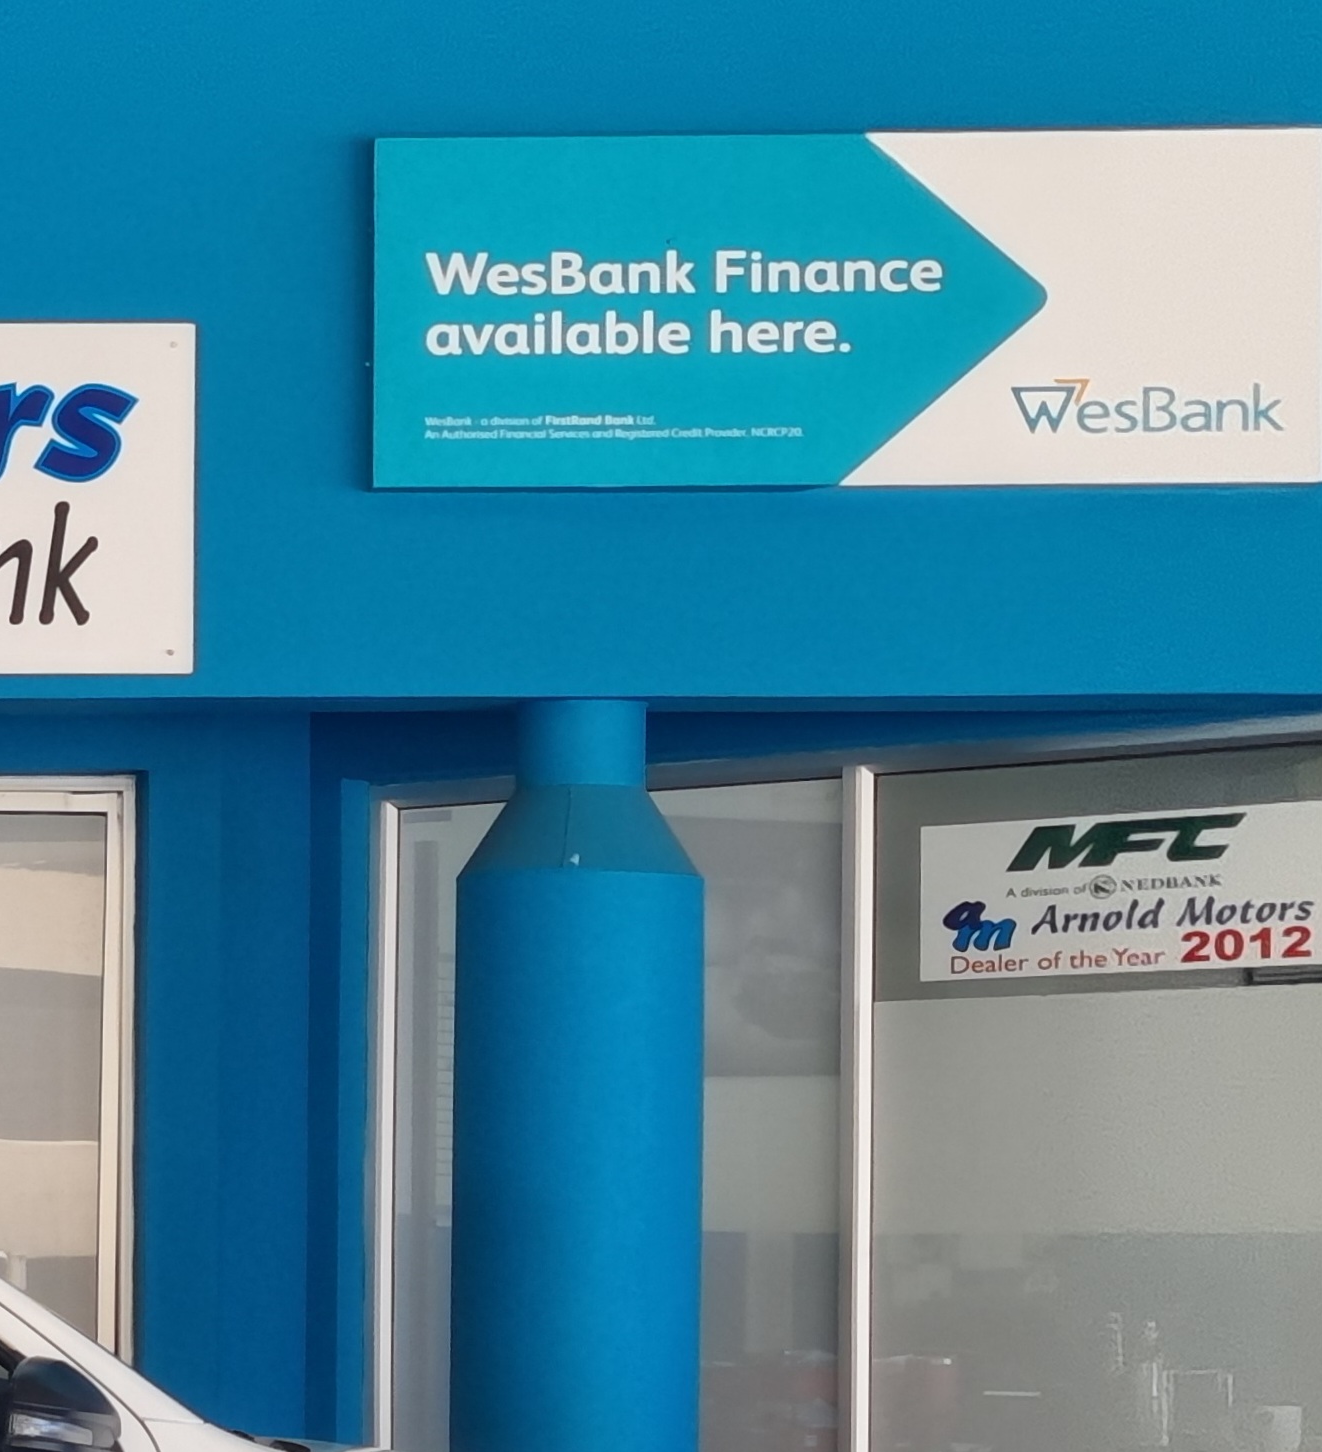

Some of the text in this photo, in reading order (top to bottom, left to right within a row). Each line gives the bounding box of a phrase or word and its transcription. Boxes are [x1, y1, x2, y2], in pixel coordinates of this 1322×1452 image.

[425, 249, 944, 295] WesBank Finance
[425, 309, 852, 355] available here.
[545, 414, 603, 426] FirstRand
[604, 414, 634, 425] Bank
[1011, 378, 1284, 435] WesBank
[592, 428, 613, 439] and
[1005, 812, 1247, 872] MFC
[1020, 884, 1069, 898] division
[1120, 873, 1223, 893] NEDBANK
[1030, 895, 1315, 936] Arnold Motors
[950, 925, 1314, 975] Dealer of the Year 2012
